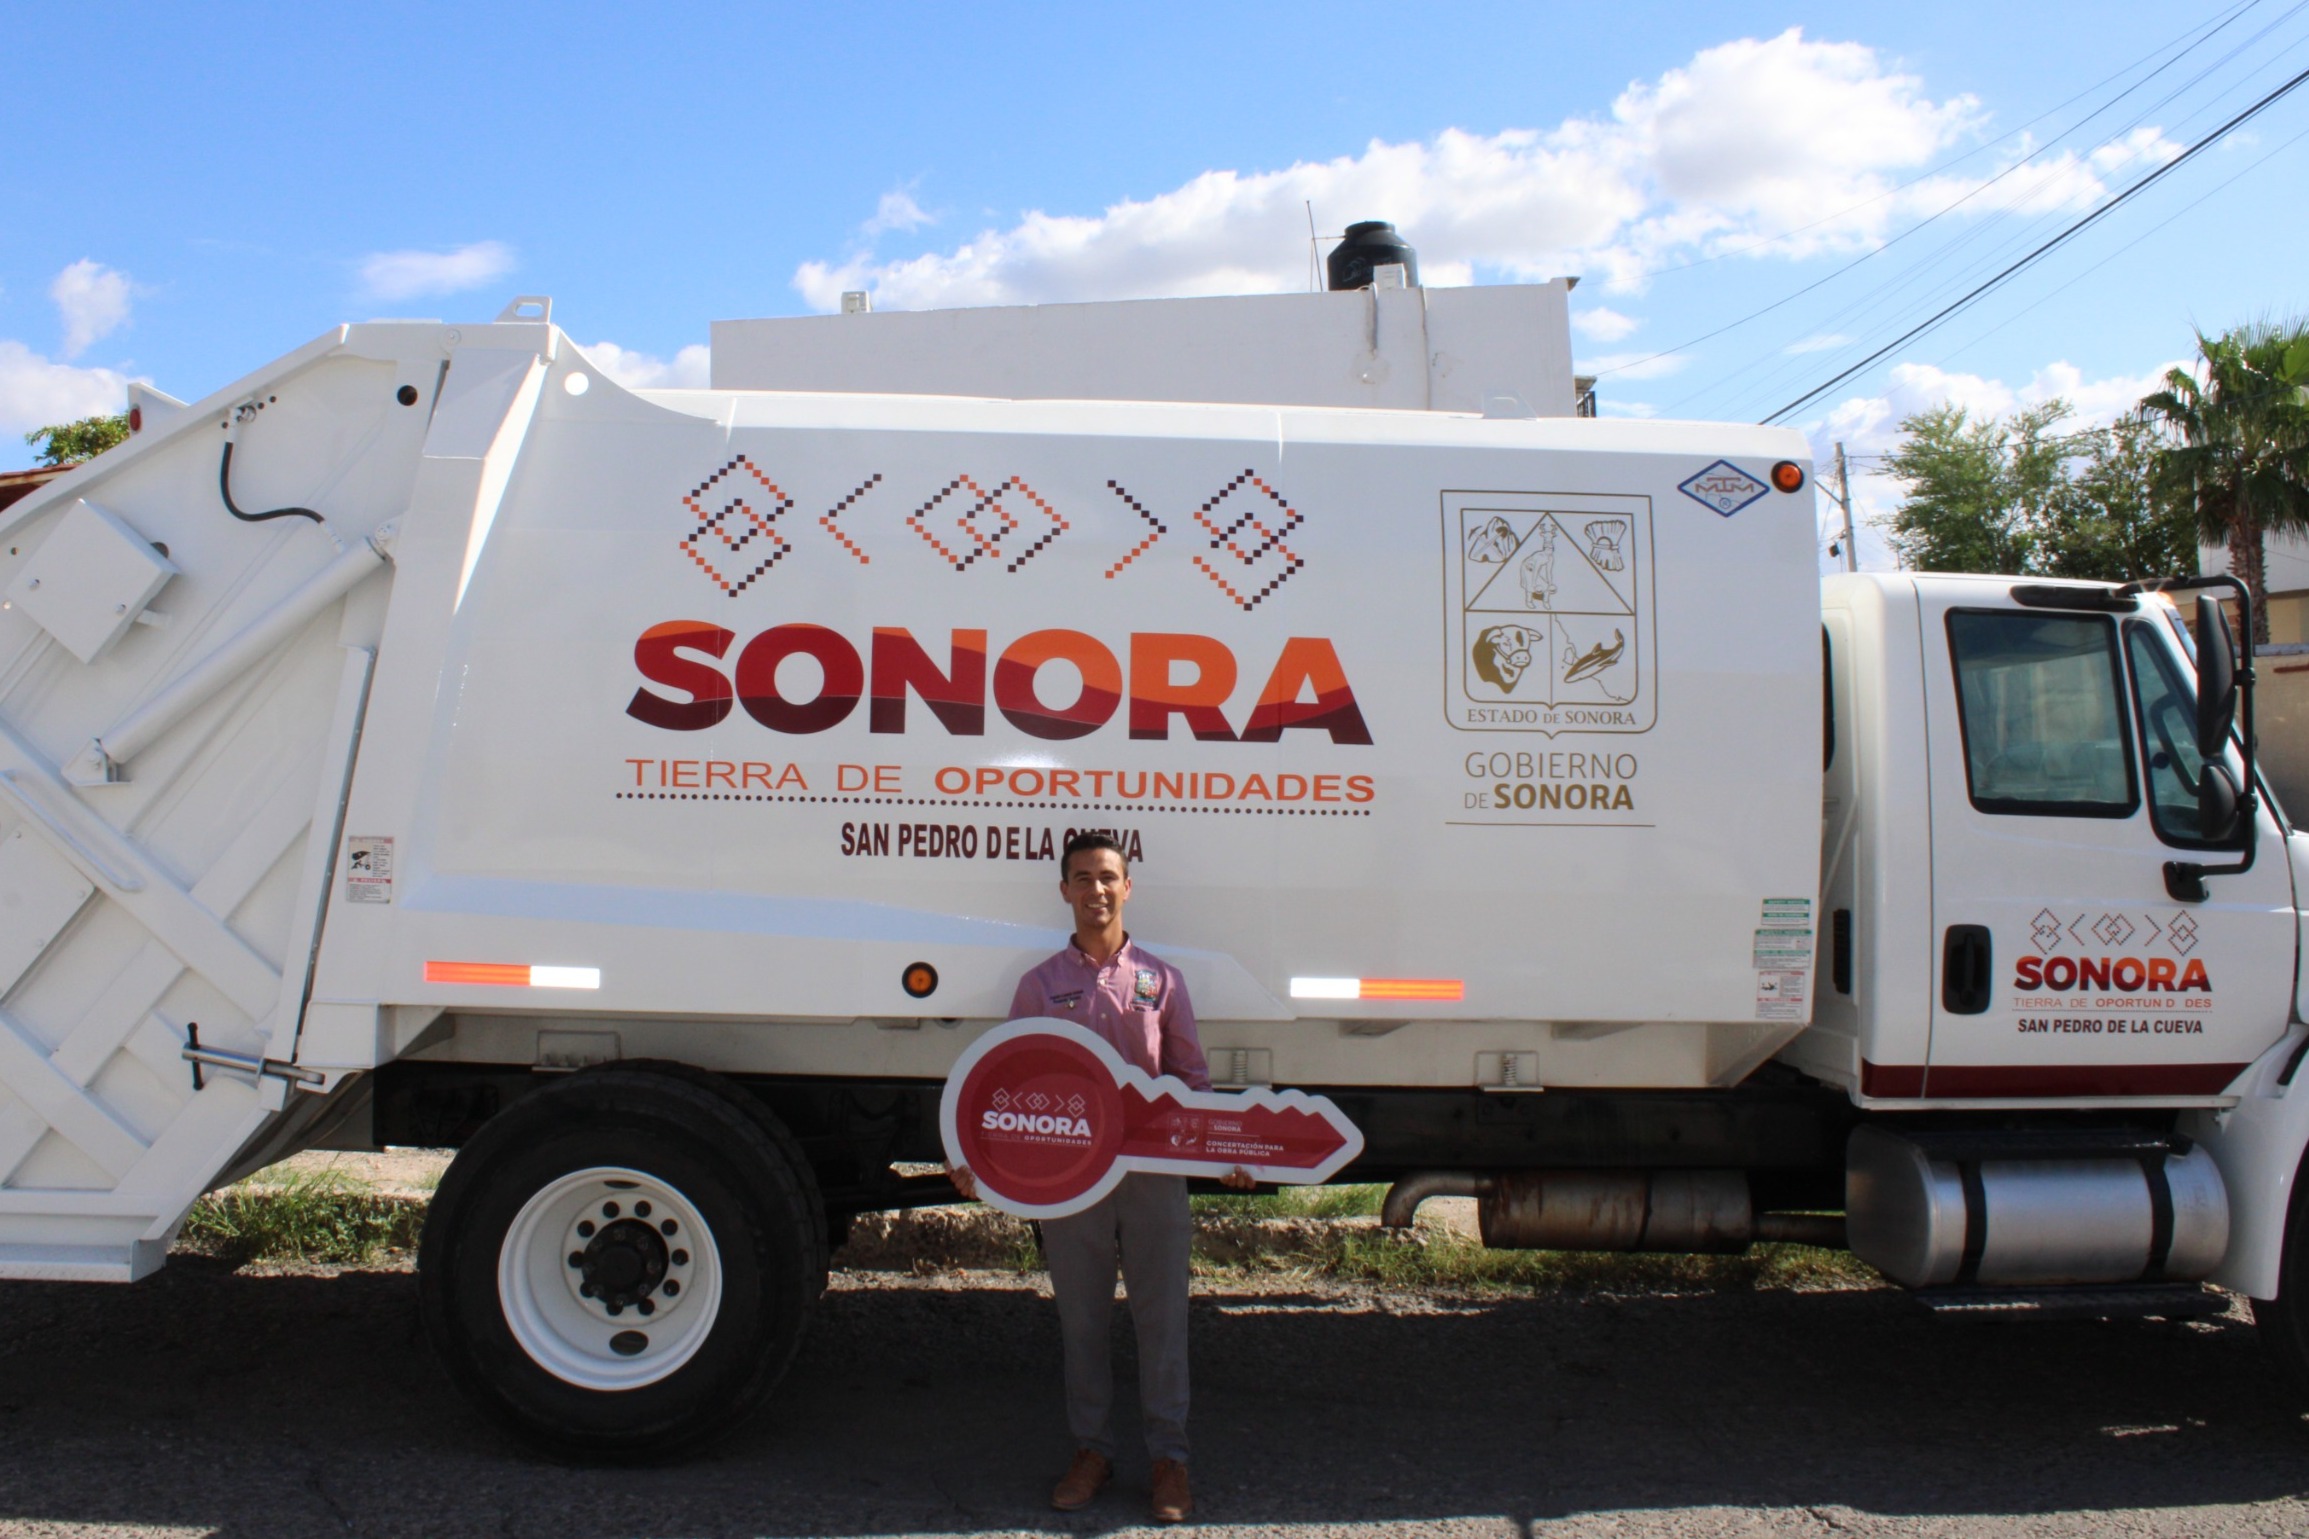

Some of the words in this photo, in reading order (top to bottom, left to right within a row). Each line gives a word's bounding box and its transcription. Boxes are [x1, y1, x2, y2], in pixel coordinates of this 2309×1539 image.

[625, 619, 1375, 745] SONORA
[1467, 709, 1538, 724] ESTADO
[1543, 713, 1561, 725] DE
[1565, 710, 1637, 725] SONORA
[1465, 752, 1637, 780] GOBIERNO
[625, 759, 808, 790] TIERRA
[837, 764, 903, 793] DE
[934, 766, 1375, 802] OPORTUNIDADES
[1464, 793, 1488, 809] DE
[1494, 783, 1634, 810] SONORA
[841, 822, 890, 857] SAN
[898, 823, 978, 859] PEDRO
[2014, 956, 2213, 992] SONORA
[2014, 997, 2062, 1008] TIERRA
[2070, 998, 2088, 1008] DE
[2018, 1019, 2048, 1033] SAN
[2053, 1019, 2102, 1034] PEDRO
[2107, 1019, 2126, 1034] DE
[2131, 1020, 2149, 1034] LA
[2154, 1020, 2203, 1034] CUEVA
[982, 1110, 1092, 1137] SONORA
[1024, 1134, 1092, 1146] OPORTUNIDADES
[1206, 1140, 1263, 1150] CONCERTACIÓN
